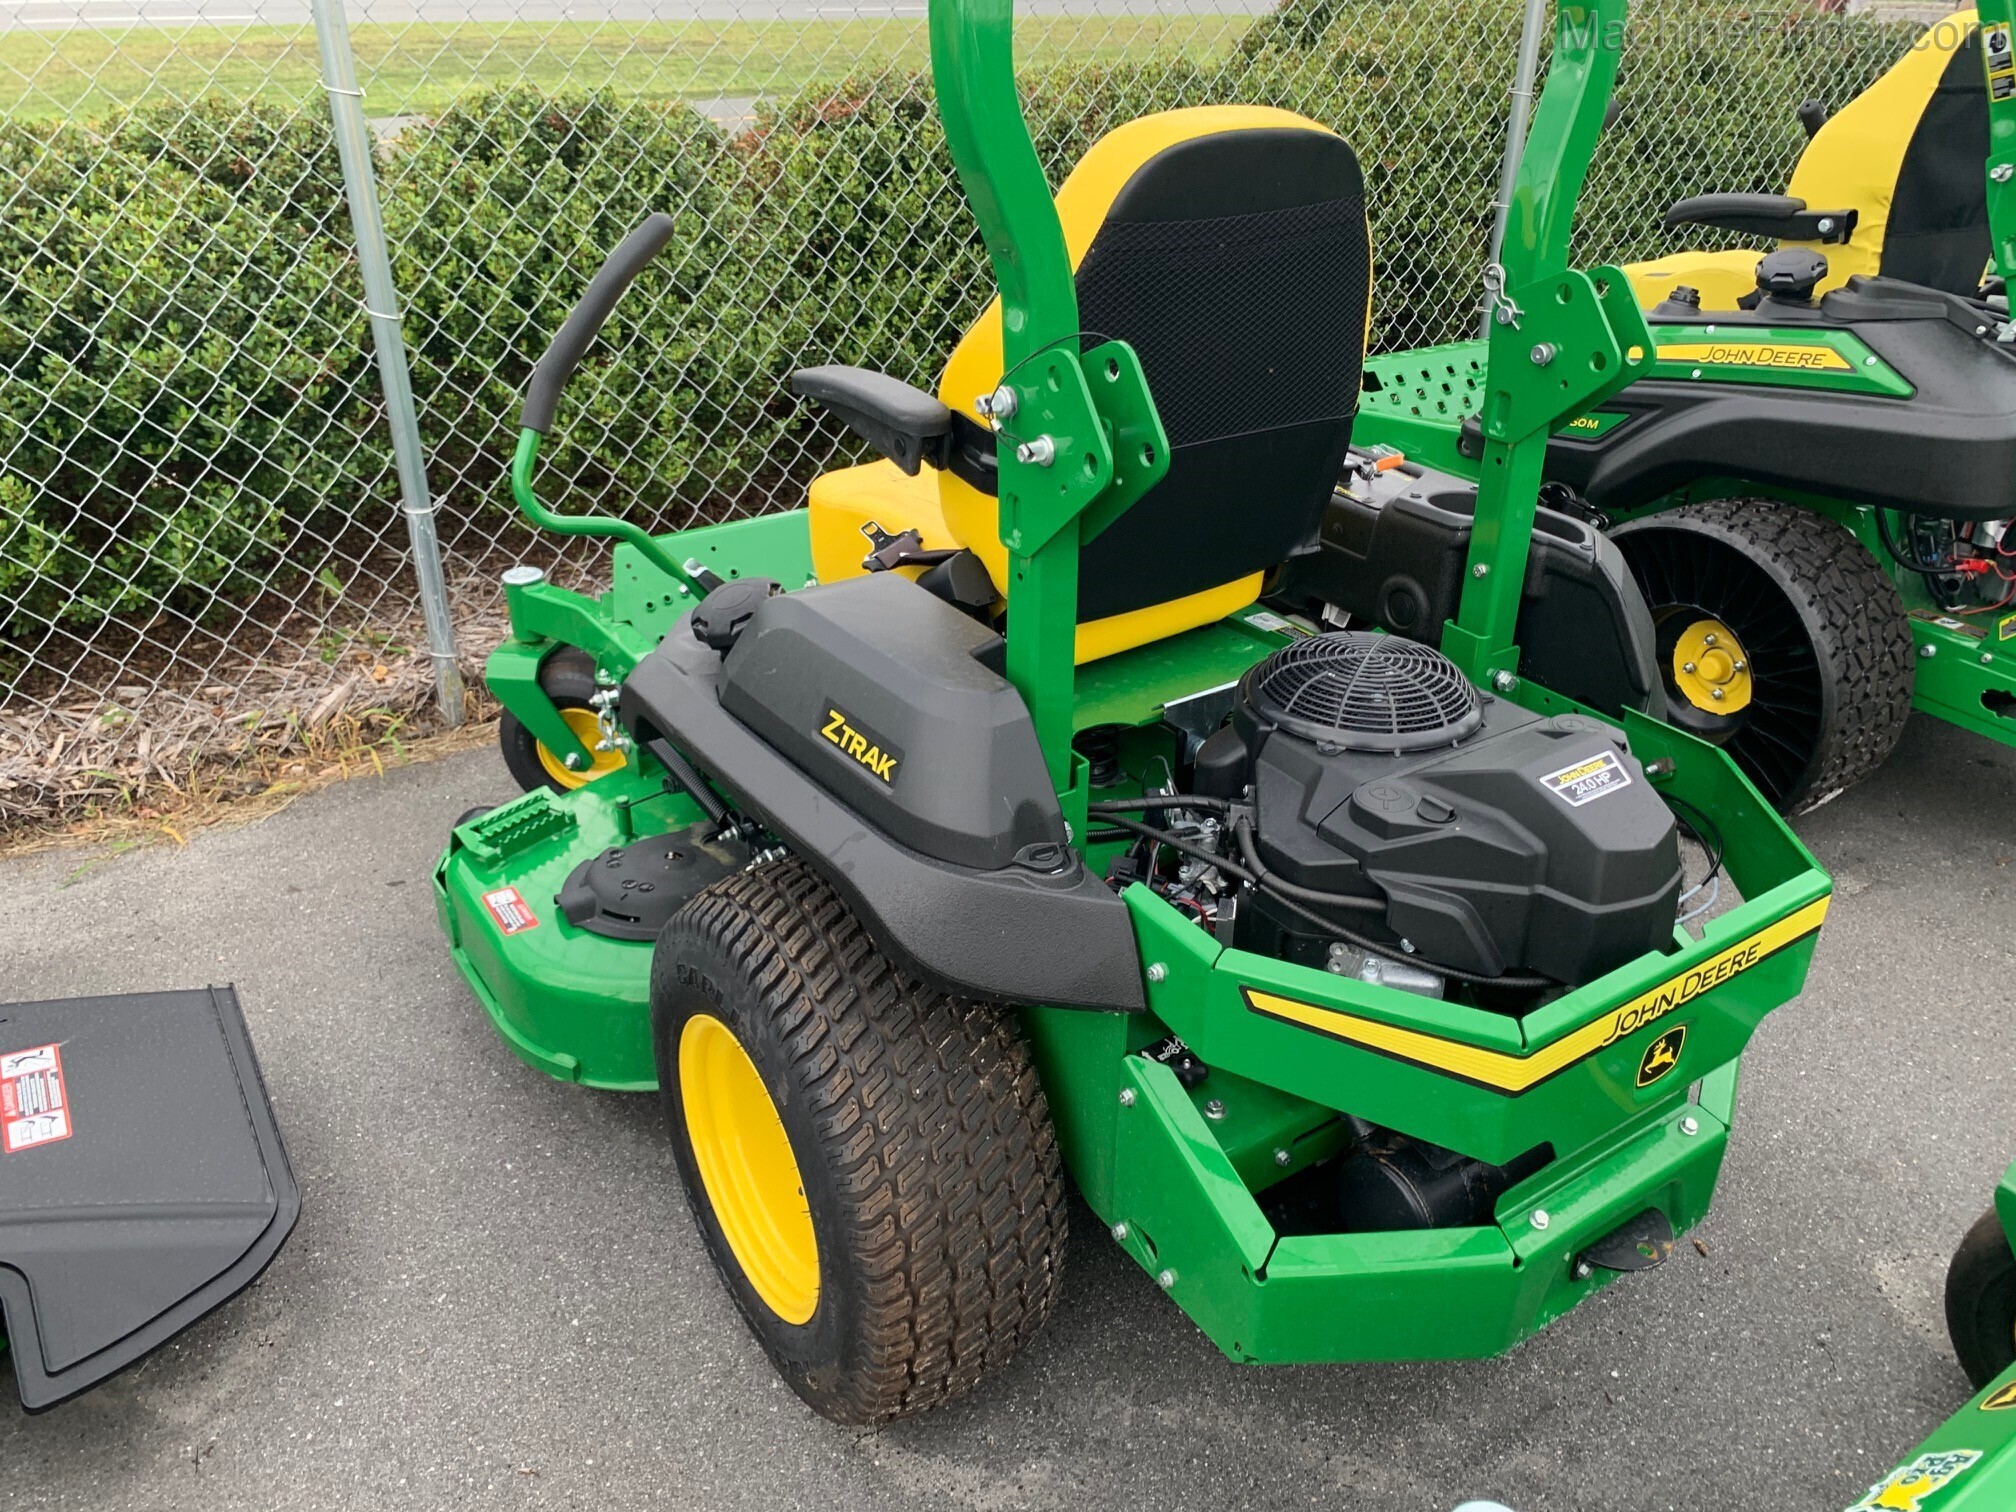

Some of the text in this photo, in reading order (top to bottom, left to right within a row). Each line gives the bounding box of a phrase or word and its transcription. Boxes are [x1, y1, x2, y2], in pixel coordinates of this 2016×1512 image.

[1701, 346, 1827, 366] JOHN DEERE
[821, 709, 898, 782] ZTRAK
[1558, 759, 1607, 785] JOHN DEERE
[1571, 779, 1598, 796] 24.0
[1595, 771, 1612, 787] HP
[1602, 941, 1762, 1044] JOHN DEERE
